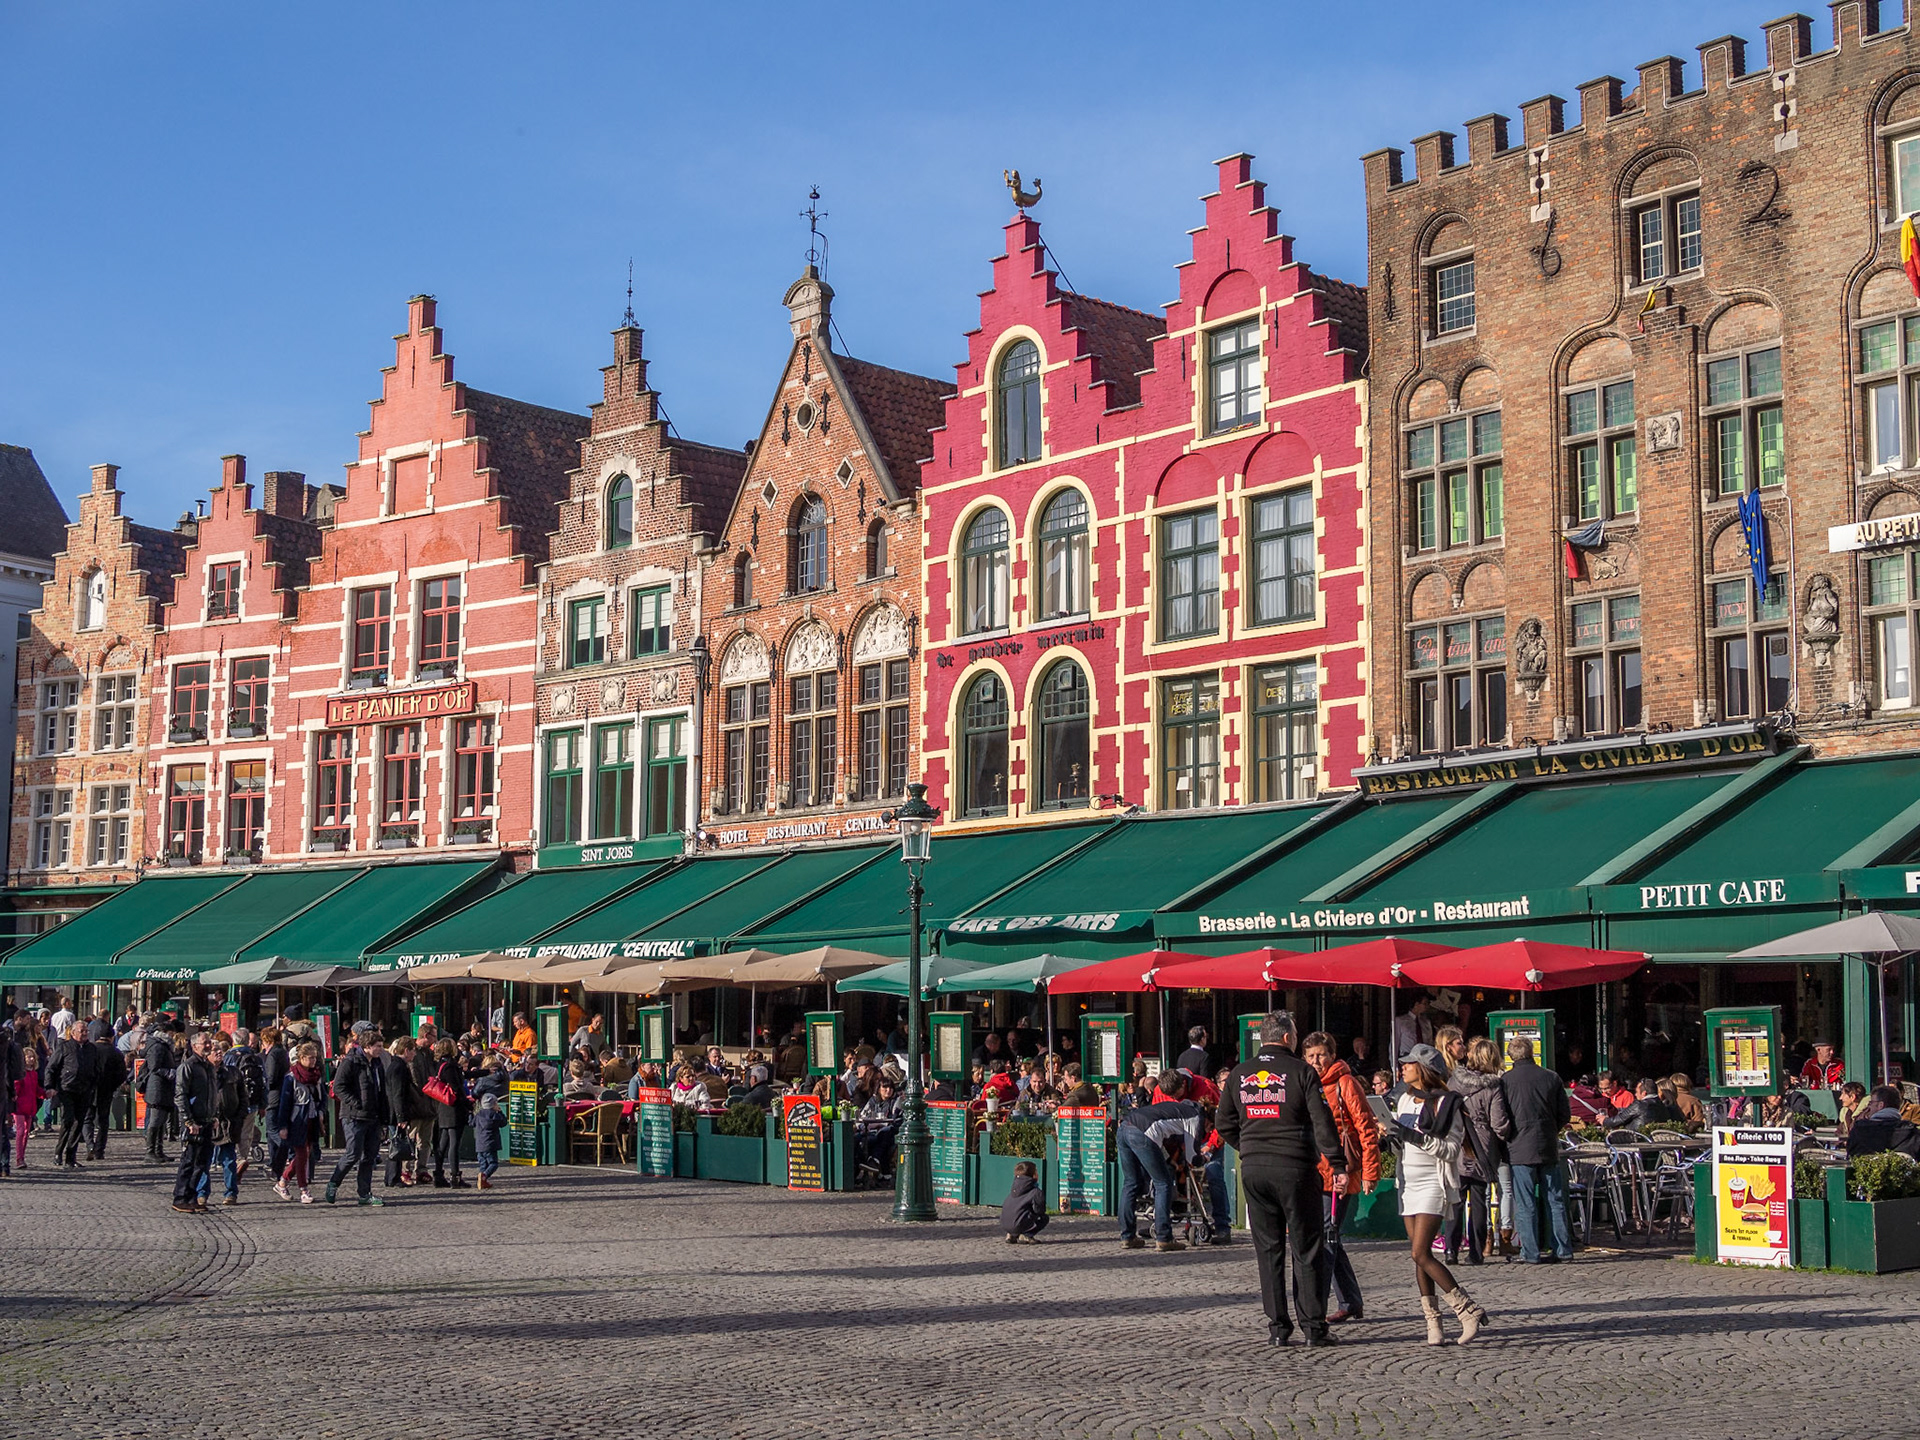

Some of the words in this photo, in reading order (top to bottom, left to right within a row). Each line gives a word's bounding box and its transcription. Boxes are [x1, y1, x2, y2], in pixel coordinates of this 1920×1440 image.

[1855, 522, 1876, 543] AU
[1880, 515, 1920, 539] PETI
[1416, 633, 1507, 663] Retauant
[332, 705, 353, 722] LE
[357, 694, 422, 719] PANIER
[427, 687, 469, 712] D'OR
[1368, 760, 1519, 795] RESTAURANT
[1534, 755, 1569, 776] LA
[1580, 742, 1686, 771] CIVIERE
[1702, 731, 1767, 758] D'OR
[720, 829, 749, 844] HOTEL
[766, 821, 828, 840] RESTAURANT
[581, 848, 604, 862] SINT
[605, 845, 634, 860] JORIS
[1639, 883, 1712, 909] PETIT
[1717, 878, 1787, 905] CAFE
[948, 917, 1006, 932] CAFE
[1005, 916, 1053, 931] DES
[1050, 913, 1120, 931] ARTS
[1199, 911, 1277, 933] Brasserie
[1290, 912, 1312, 930] La
[1313, 908, 1376, 928] Civiere
[1378, 905, 1416, 925] d'Or
[1433, 895, 1530, 922] Restaurant
[535, 942, 618, 959] RESTAURANT
[368, 962, 392, 972] staurant
[395, 954, 425, 970] SINT
[135, 968, 147, 978] Le
[147, 969, 176, 979] Panier
[177, 967, 197, 978] d'Or
[1103, 1020, 1118, 1028] CAFE
[1240, 1088, 1263, 1104] Red
[1263, 1088, 1286, 1103] Bull
[1059, 1108, 1076, 1116] MENU
[1076, 1108, 1092, 1117] BELGE
[1247, 1107, 1279, 1116] TOTAL
[1736, 1132, 1763, 1141] Friterie
[1764, 1132, 1783, 1142] 1900
